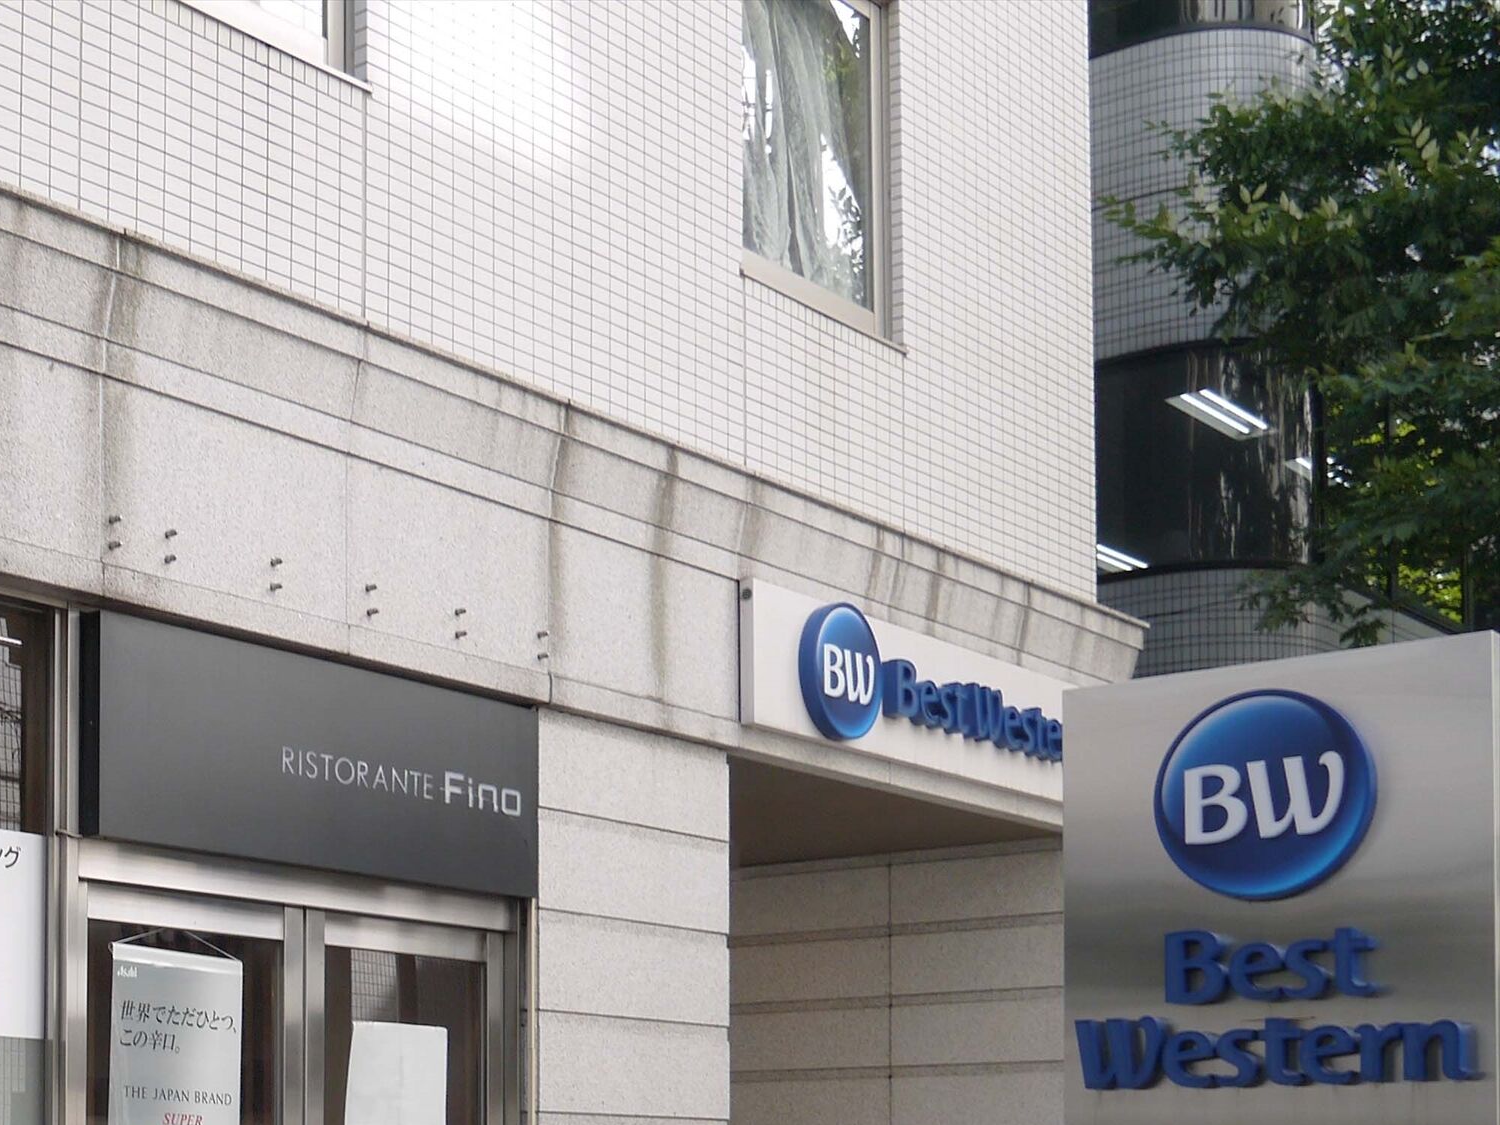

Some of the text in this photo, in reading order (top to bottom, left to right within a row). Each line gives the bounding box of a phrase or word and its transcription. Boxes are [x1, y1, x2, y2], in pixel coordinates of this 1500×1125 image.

[823, 643, 874, 705] BW
[882, 659, 975, 739] Best
[281, 745, 522, 817] RISTORANTE Fino
[1183, 750, 1345, 847] BW
[1163, 926, 1382, 1006] Best
[118, 1028, 182, 1055] この辛口。
[120, 999, 238, 1034] 世界でただひとつ、
[1075, 1015, 1482, 1090] Western
[123, 1084, 233, 1106] THE JAPAN BRAND
